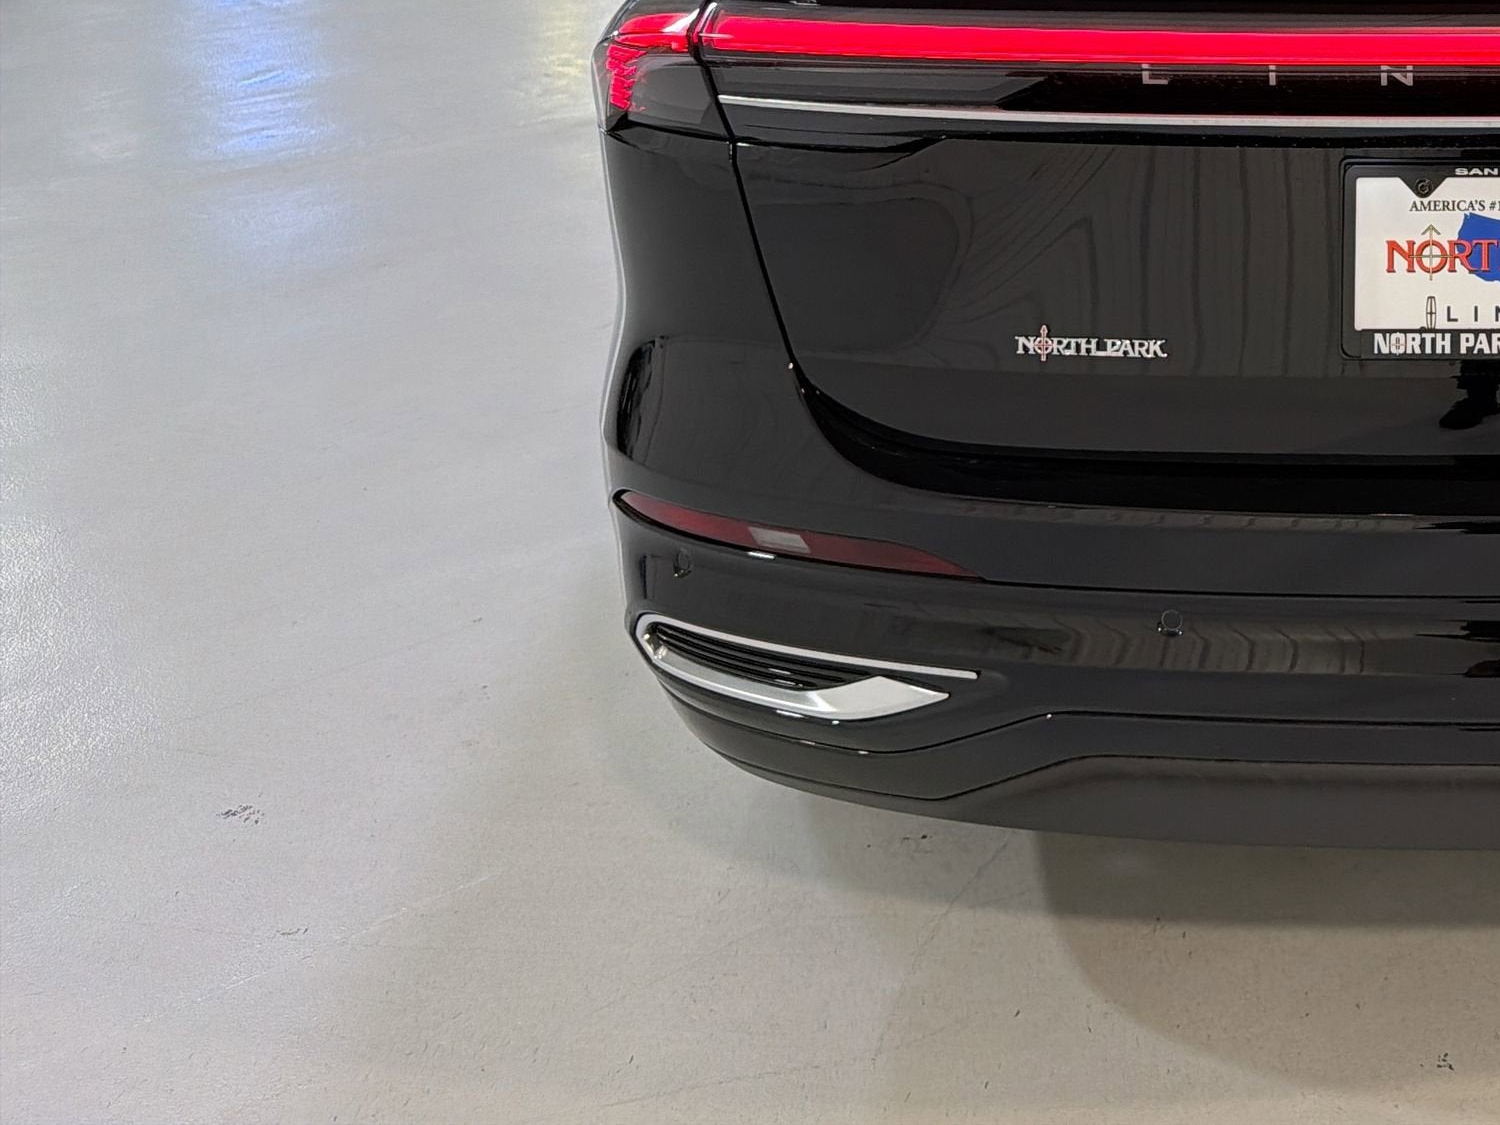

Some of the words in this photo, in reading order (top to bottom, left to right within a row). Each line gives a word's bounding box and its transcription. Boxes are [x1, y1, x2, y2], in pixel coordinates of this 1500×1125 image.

[1454, 167, 1500, 176] SAN
[1409, 199, 1486, 212] AMERICA'S
[1014, 335, 1099, 357] NORTH
[1103, 337, 1169, 358] PARK
[1373, 332, 1452, 354] NORTH
